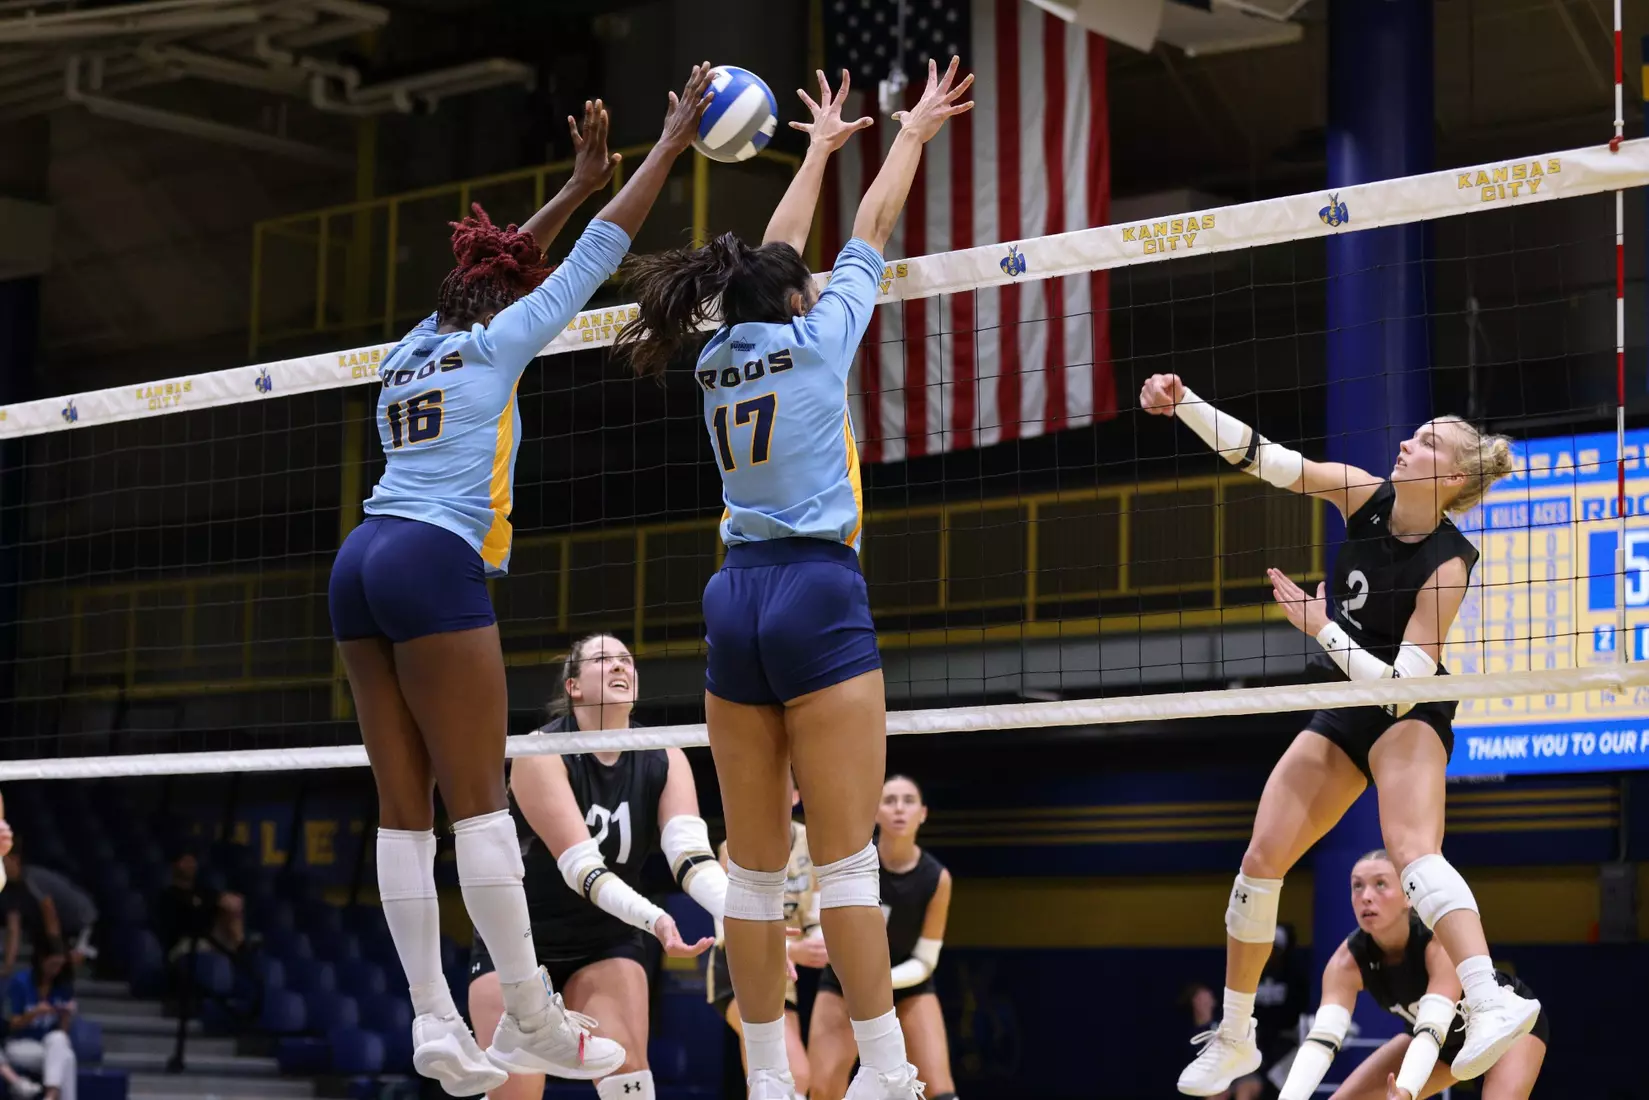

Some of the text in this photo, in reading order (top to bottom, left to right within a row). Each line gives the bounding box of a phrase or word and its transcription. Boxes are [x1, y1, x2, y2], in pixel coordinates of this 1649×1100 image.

[1457, 158, 1561, 190] KANSAS
[1481, 178, 1541, 202] CITY
[1122, 214, 1215, 242] KANSAS
[1143, 233, 1197, 254] CITY
[567, 307, 638, 331] KANSAS
[338, 349, 389, 367] KANS
[352, 363, 379, 379] CIT
[382, 350, 464, 388] ROOS
[697, 348, 793, 390] ROOS
[135, 380, 192, 400] KANSAS
[148, 394, 181, 411] CITY
[386, 388, 444, 449] 16
[713, 391, 778, 472] 17
[1506, 448, 1600, 482] NSAS
[1532, 501, 1569, 525] ACES
[1624, 530, 1649, 606] 5
[1340, 569, 1370, 631] 2
[1466, 735, 1529, 760] THANK
[1532, 733, 1569, 758] YOU
[1571, 731, 1597, 756] TO
[1599, 729, 1638, 754] OUR
[584, 801, 631, 864] 21
